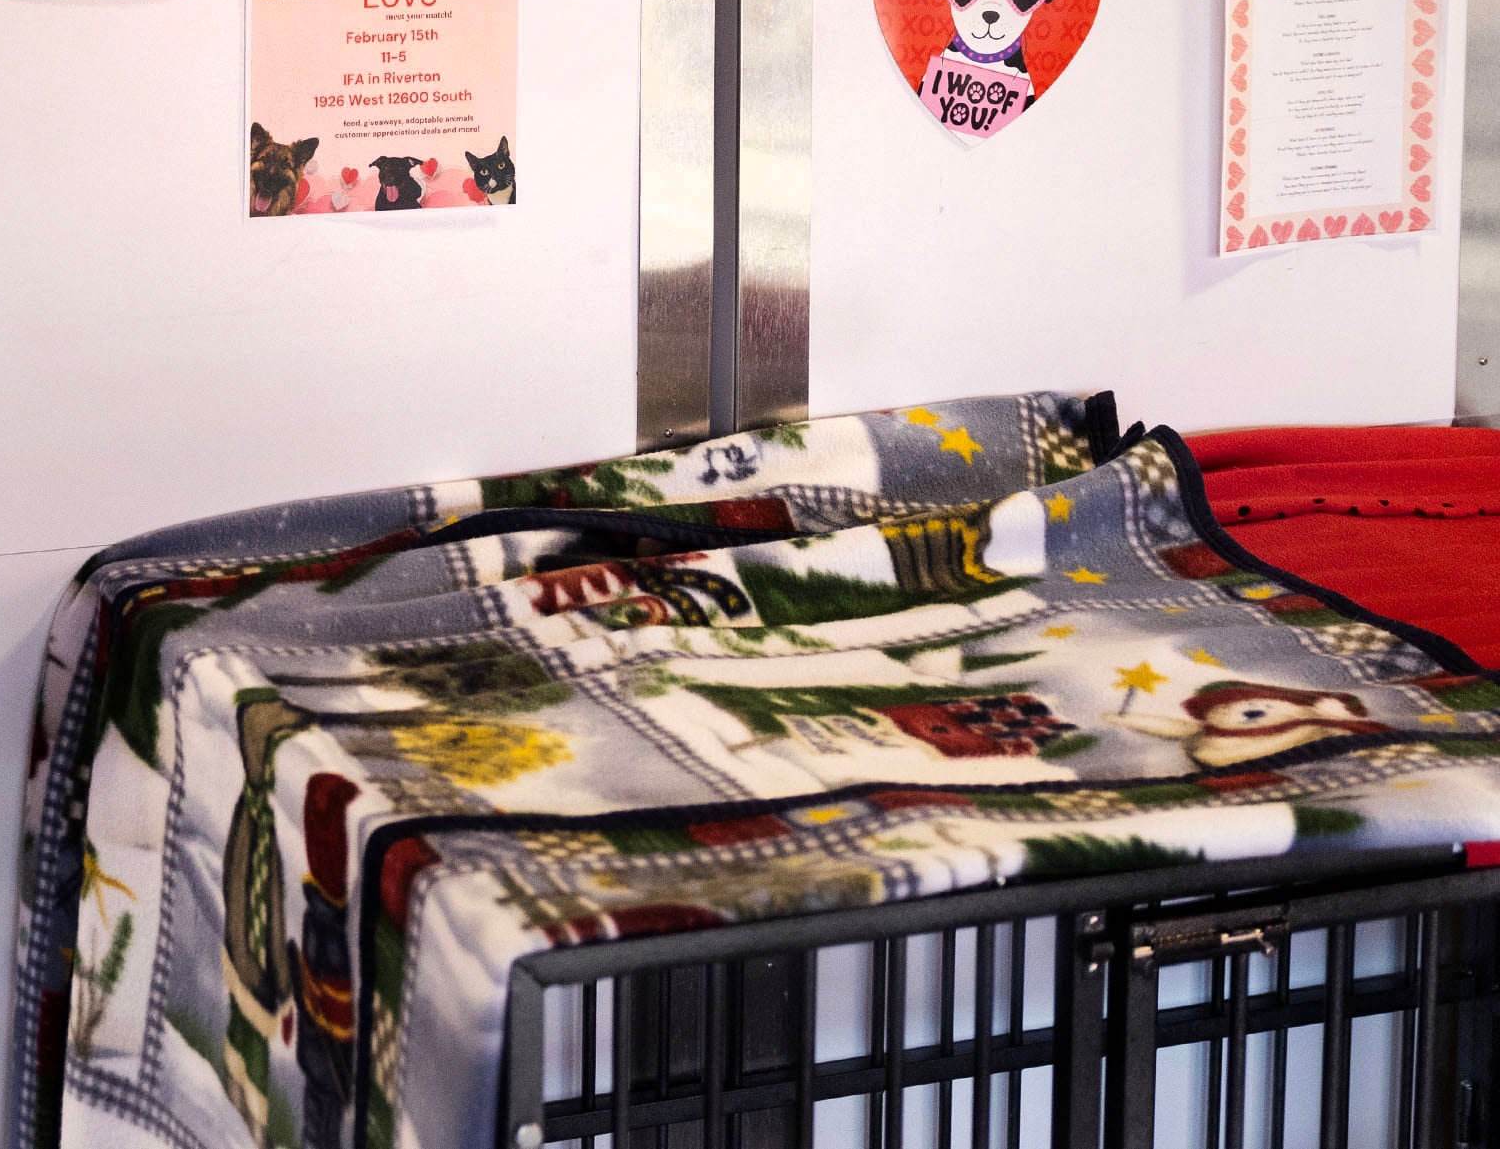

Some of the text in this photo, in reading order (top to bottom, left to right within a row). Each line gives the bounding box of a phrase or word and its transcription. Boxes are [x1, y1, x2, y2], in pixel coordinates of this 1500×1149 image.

[385, 10, 453, 23] meet your match!
[346, 28, 439, 45] February 15th
[343, 71, 441, 86] IFA in Riverton
[313, 89, 472, 108] 1926 West 12600 South
[931, 69, 1020, 114] I WOOF
[363, 118, 404, 129] giveaways,
[405, 116, 444, 126] adoptable
[445, 114, 475, 124] animals
[940, 96, 999, 132] YOU!
[334, 124, 481, 140] customer appreciation deals and more!
